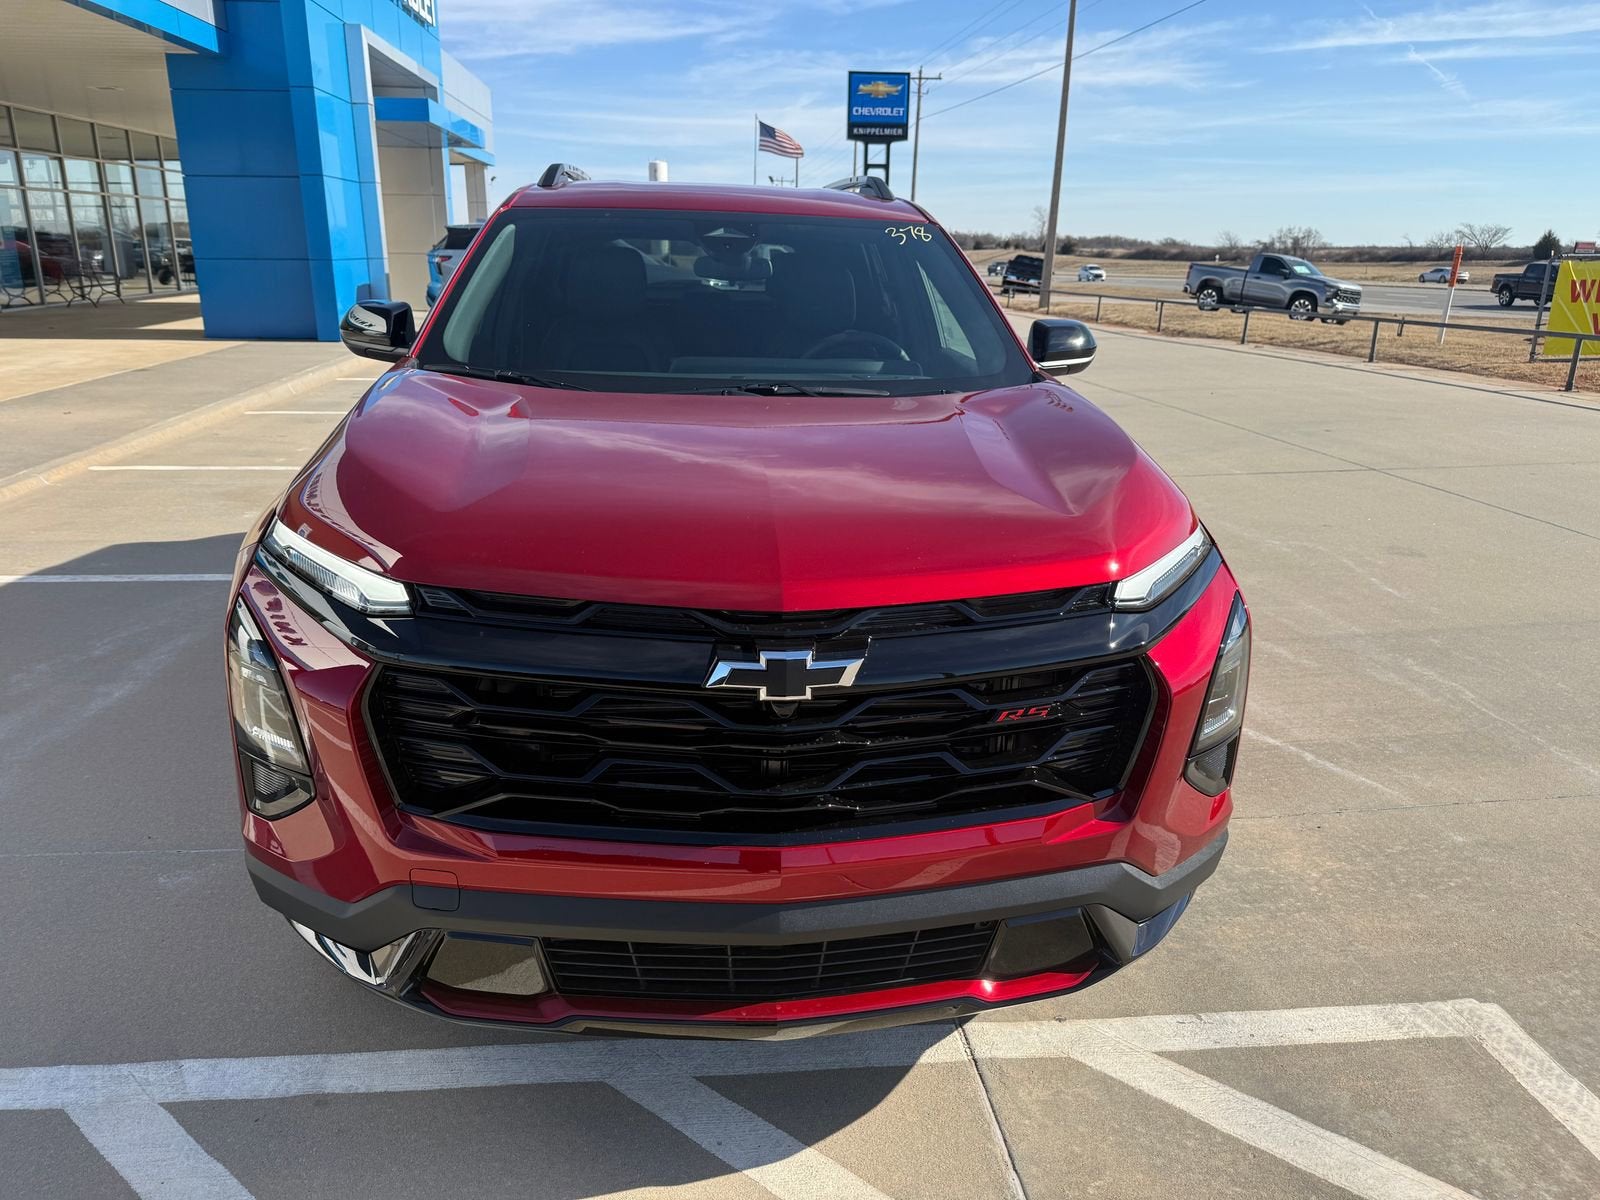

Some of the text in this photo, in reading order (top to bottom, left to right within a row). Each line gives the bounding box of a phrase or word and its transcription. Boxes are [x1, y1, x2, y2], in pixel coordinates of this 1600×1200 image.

[852, 106, 904, 117] CHEVROLET
[853, 127, 903, 136] KNIPPELMIER
[885, 225, 932, 245] 378
[996, 704, 1052, 723] RS
